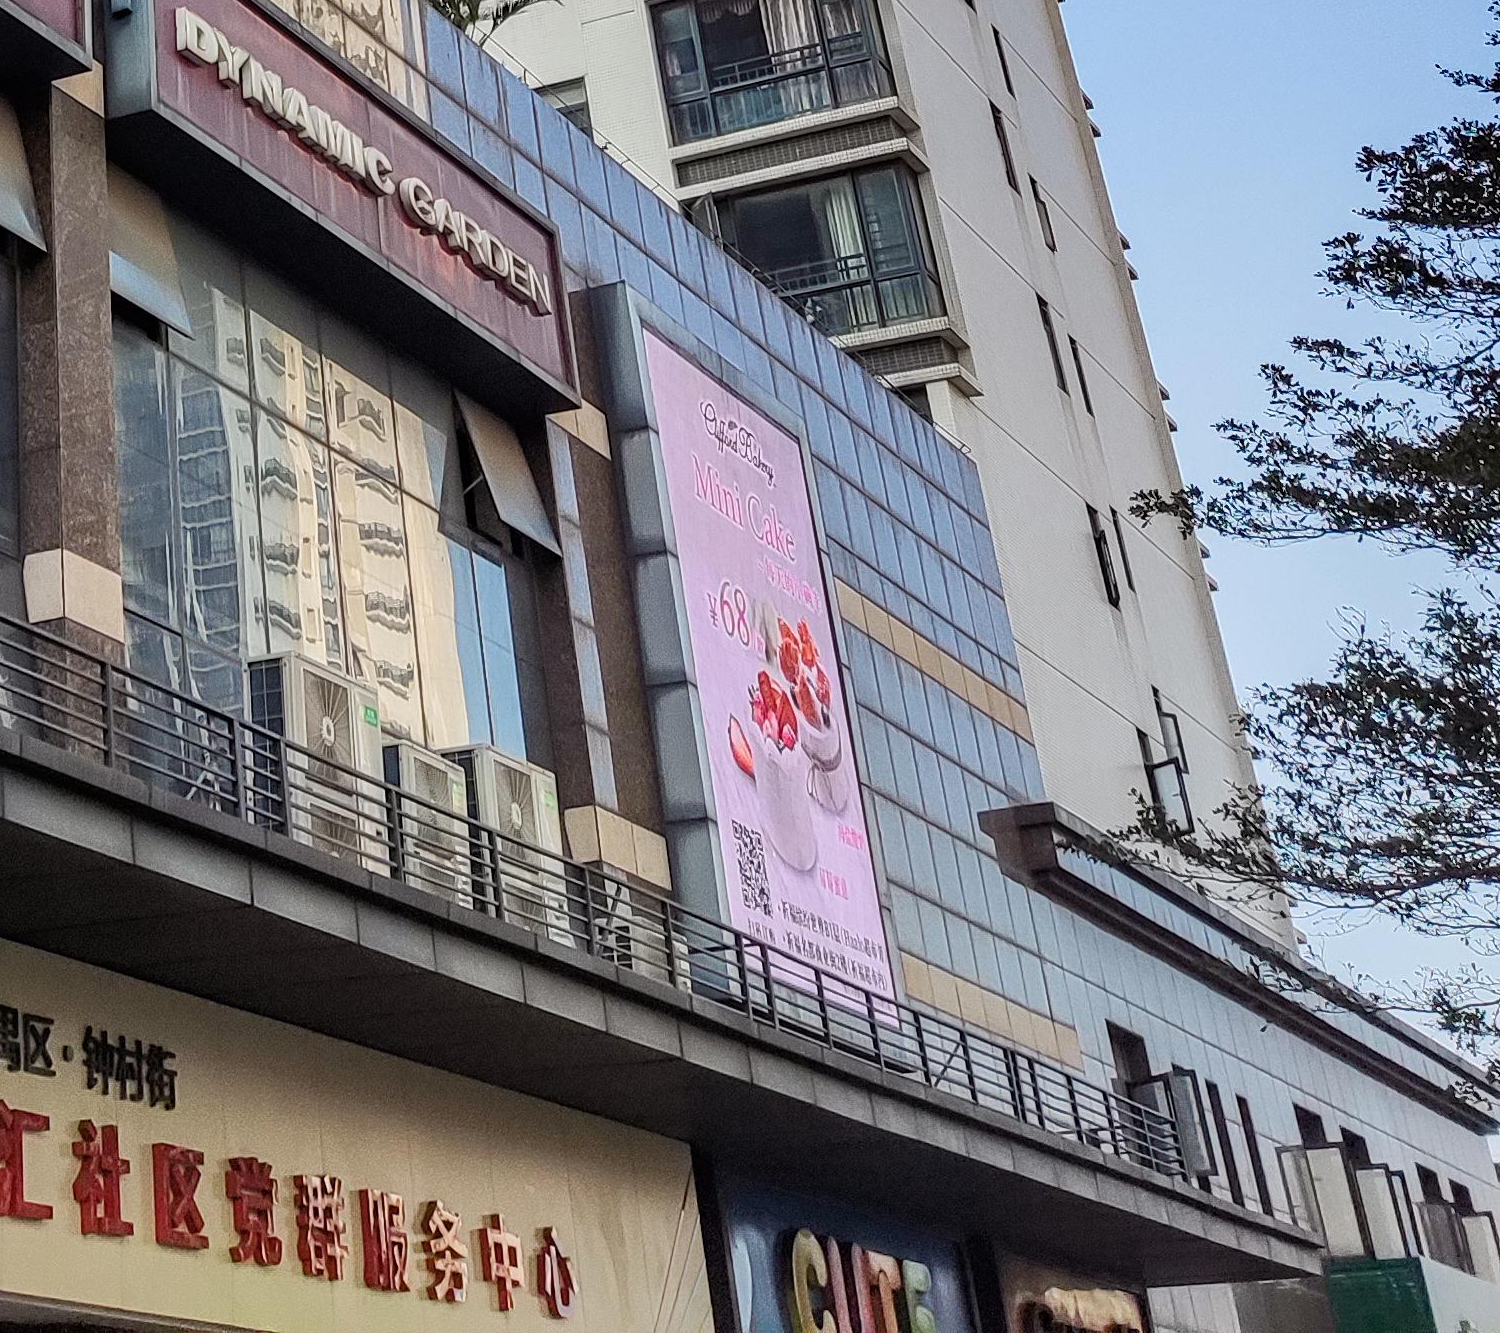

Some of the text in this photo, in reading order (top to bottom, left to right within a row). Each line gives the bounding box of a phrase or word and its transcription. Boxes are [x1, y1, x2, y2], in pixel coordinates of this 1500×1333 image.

[174, 6, 553, 317] DYNAMIC GARDEN
[692, 453, 796, 562] Mini Cake
